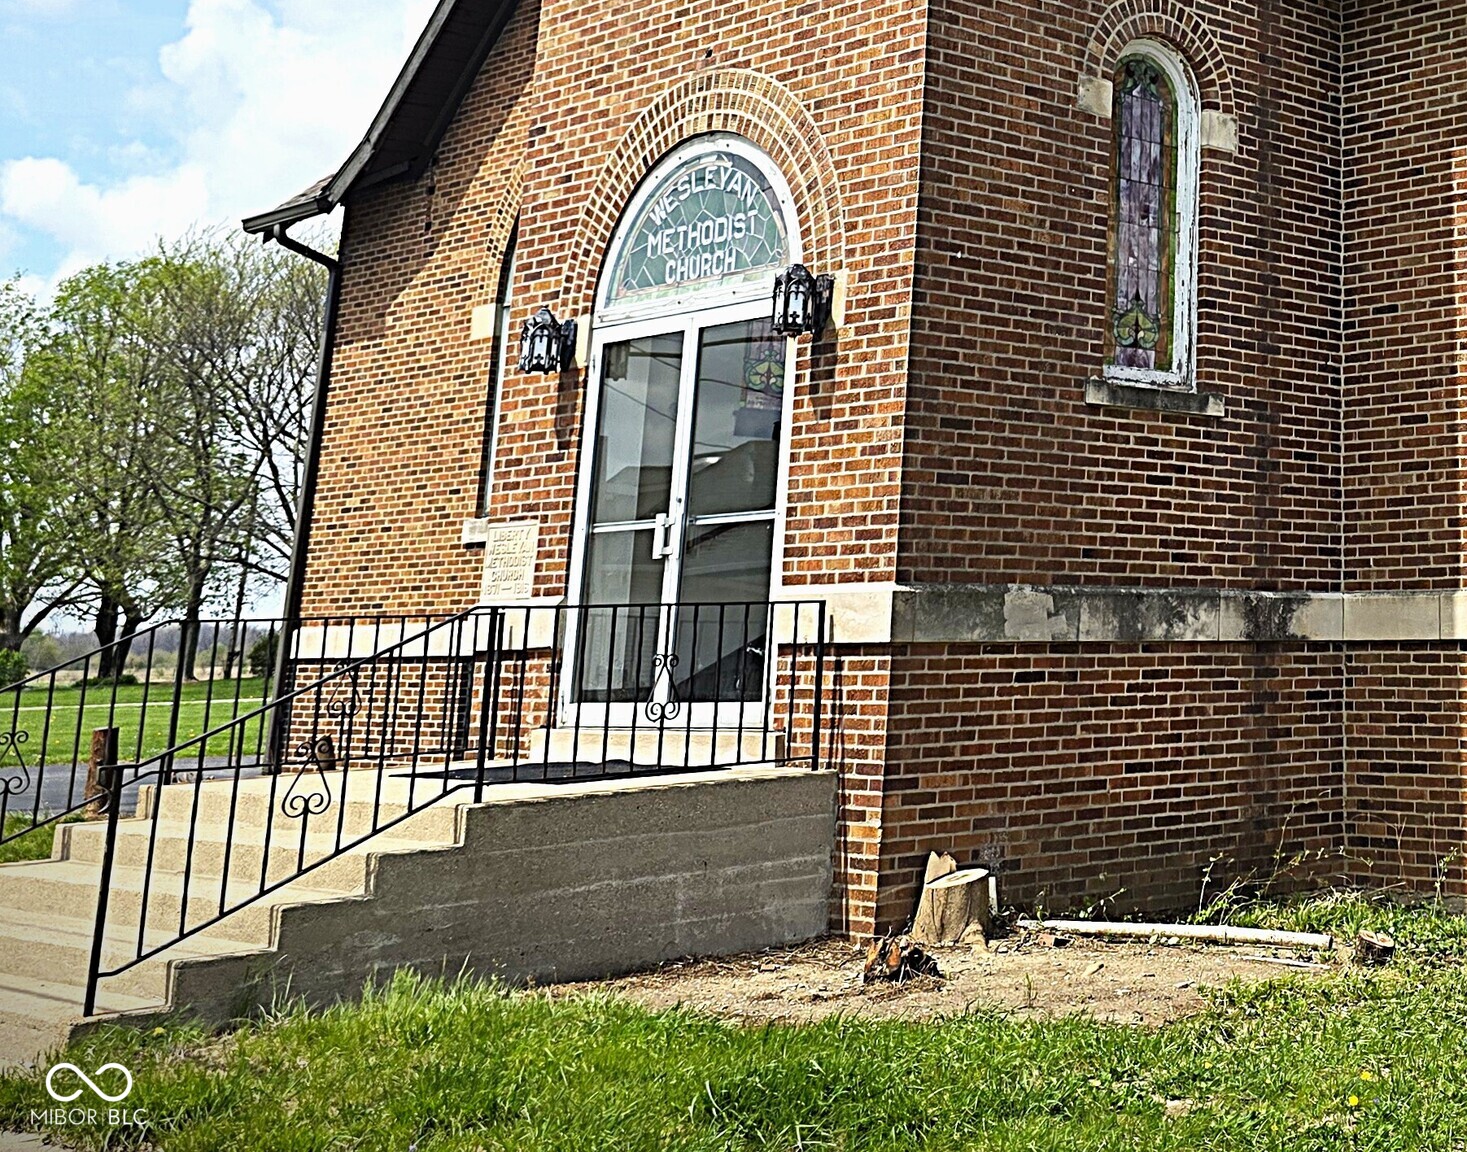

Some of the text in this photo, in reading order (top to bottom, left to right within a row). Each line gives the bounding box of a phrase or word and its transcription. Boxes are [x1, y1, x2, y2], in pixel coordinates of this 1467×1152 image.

[650, 165, 759, 226] WESLEYAN
[647, 209, 758, 256] METHODIST
[665, 250, 736, 284] CHURCH
[491, 528, 532, 543] LIBERTY
[490, 569, 526, 583] CHURCH
